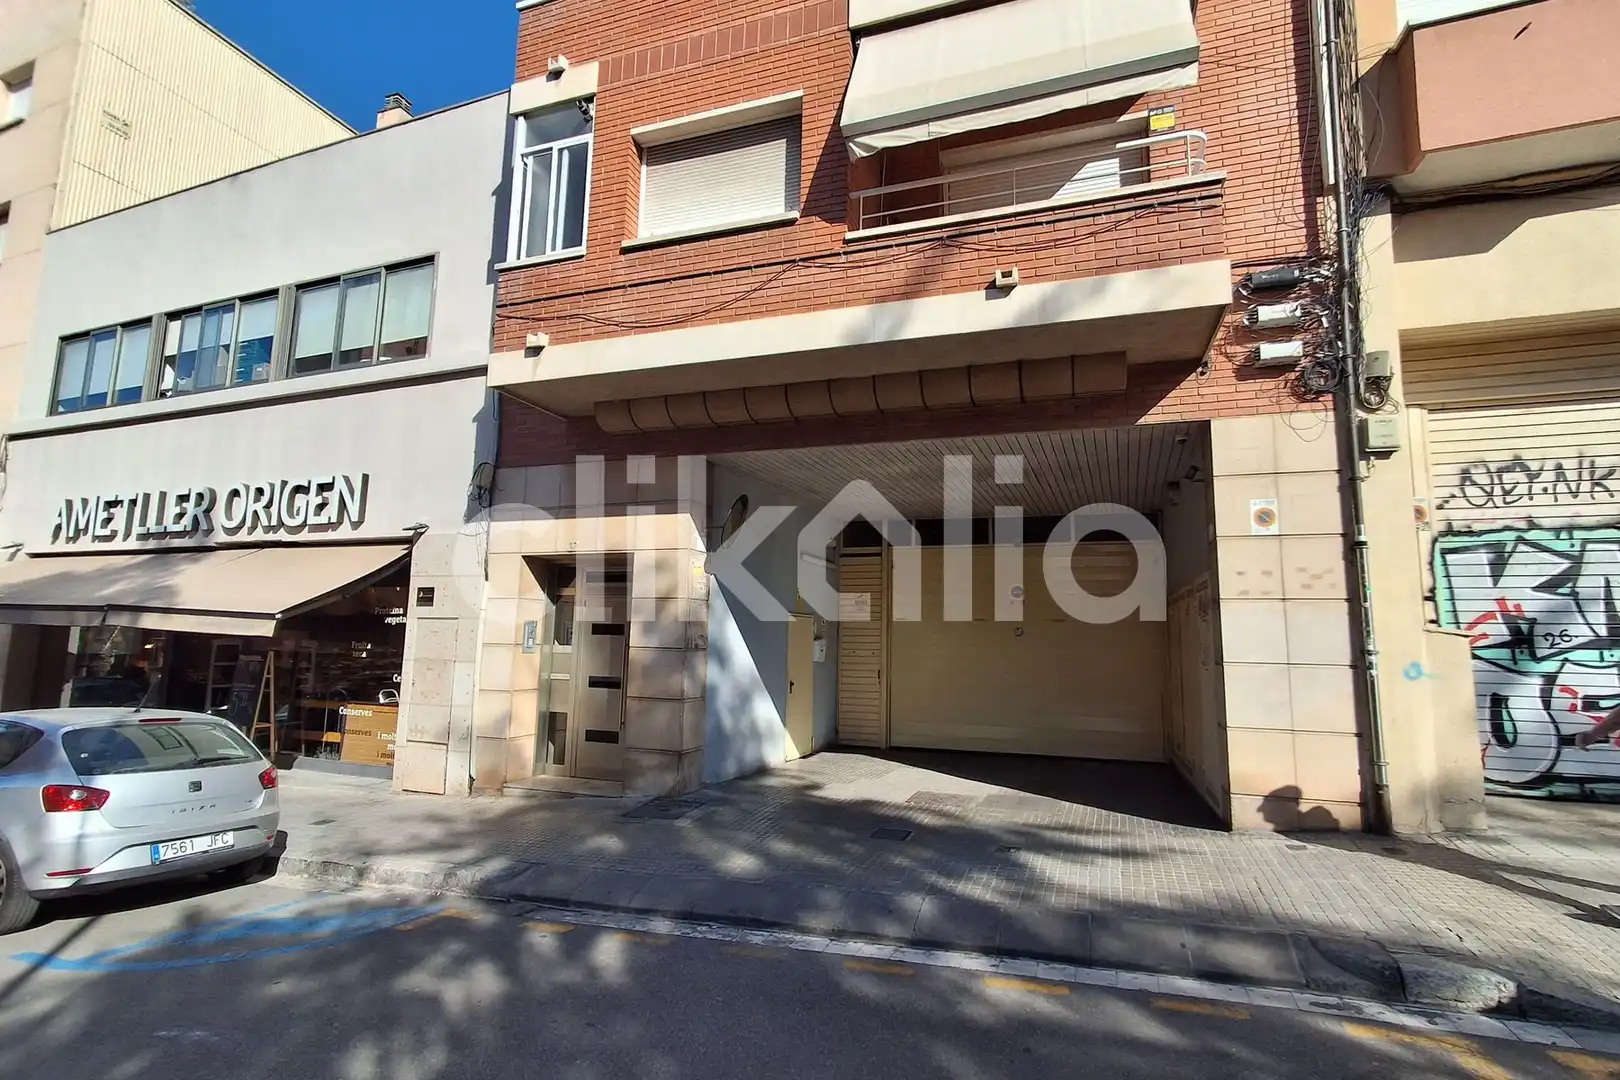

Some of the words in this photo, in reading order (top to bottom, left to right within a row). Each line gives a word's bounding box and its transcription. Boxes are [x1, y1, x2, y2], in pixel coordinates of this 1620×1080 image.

[50, 486, 217, 545] AMETLLER
[220, 472, 370, 537] ORIGEN
[384, 615, 407, 626] vegeta
[339, 706, 373, 717] Conserves
[162, 840, 194, 857] 7561
[207, 832, 229, 848] JFC
